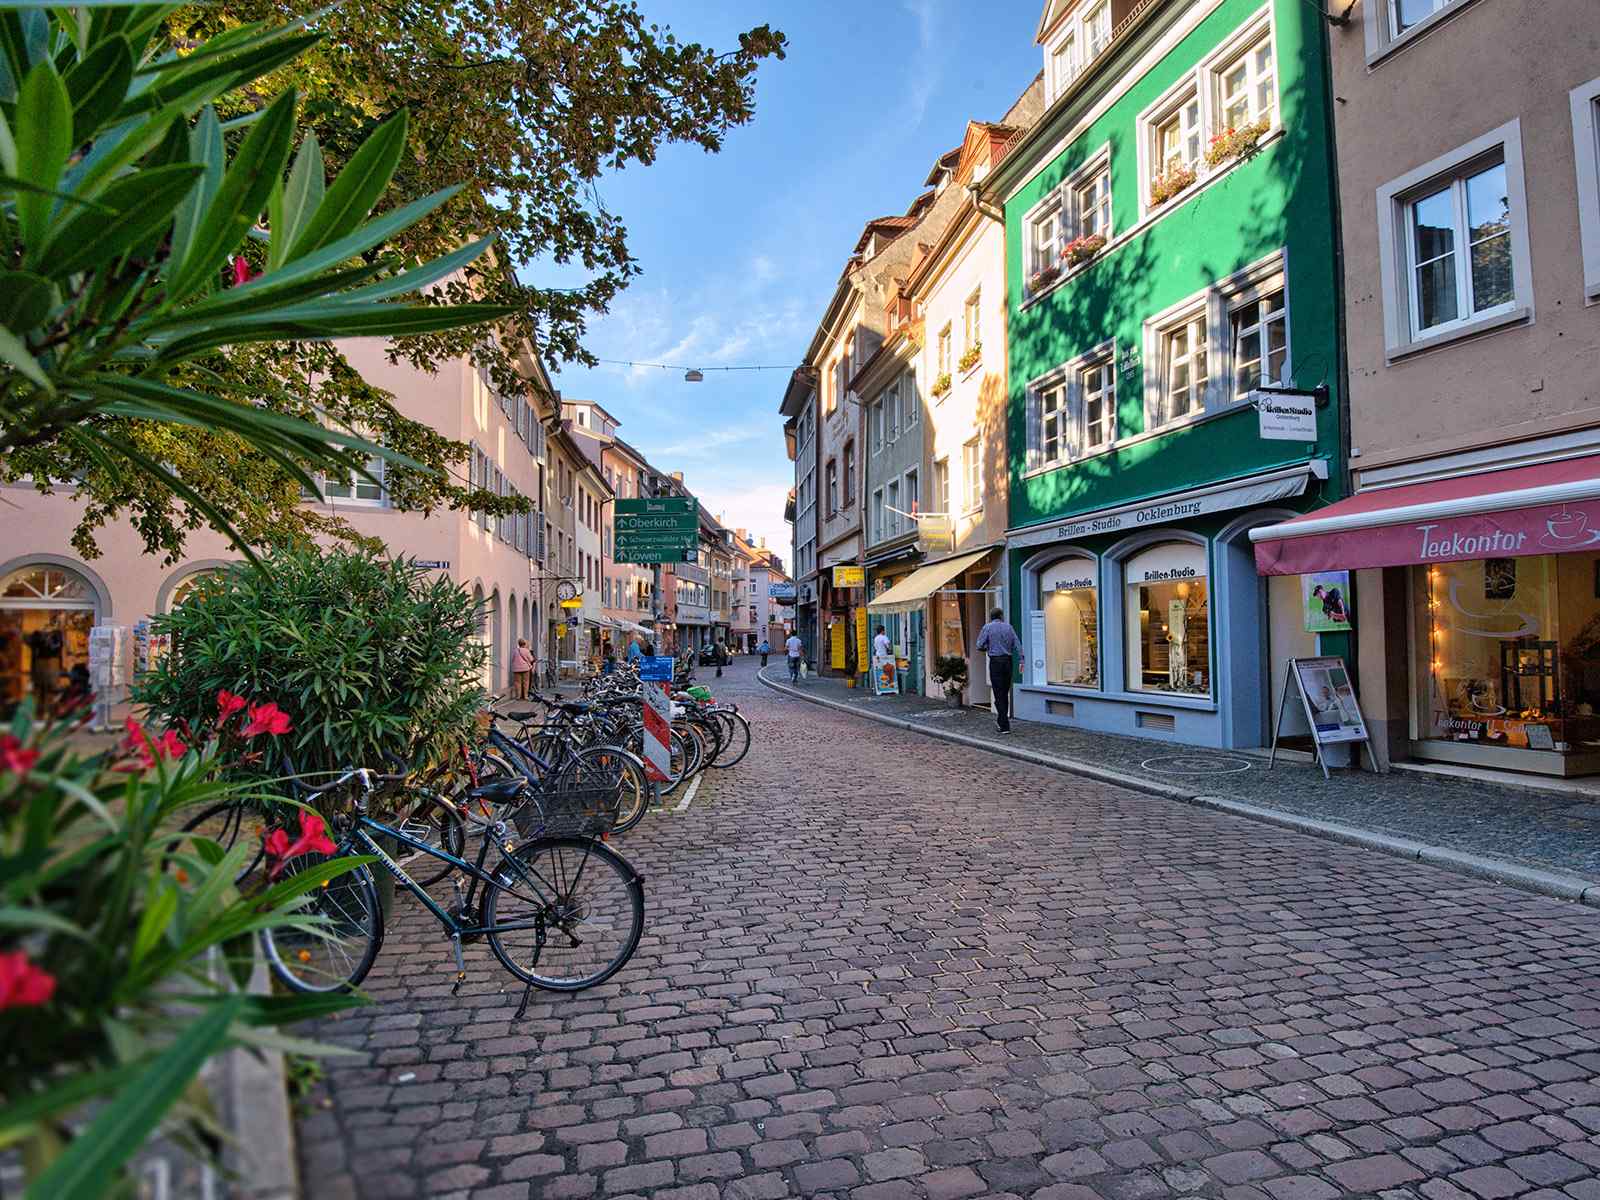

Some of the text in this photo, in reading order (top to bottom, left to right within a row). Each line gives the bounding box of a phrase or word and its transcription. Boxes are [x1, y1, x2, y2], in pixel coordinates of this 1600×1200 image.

[1136, 501, 1202, 523] Ocklenburg
[628, 518, 677, 529] Oberkirch
[1416, 525, 1527, 558] Teekontor
[1144, 566, 1196, 581] Brillen-Studio
